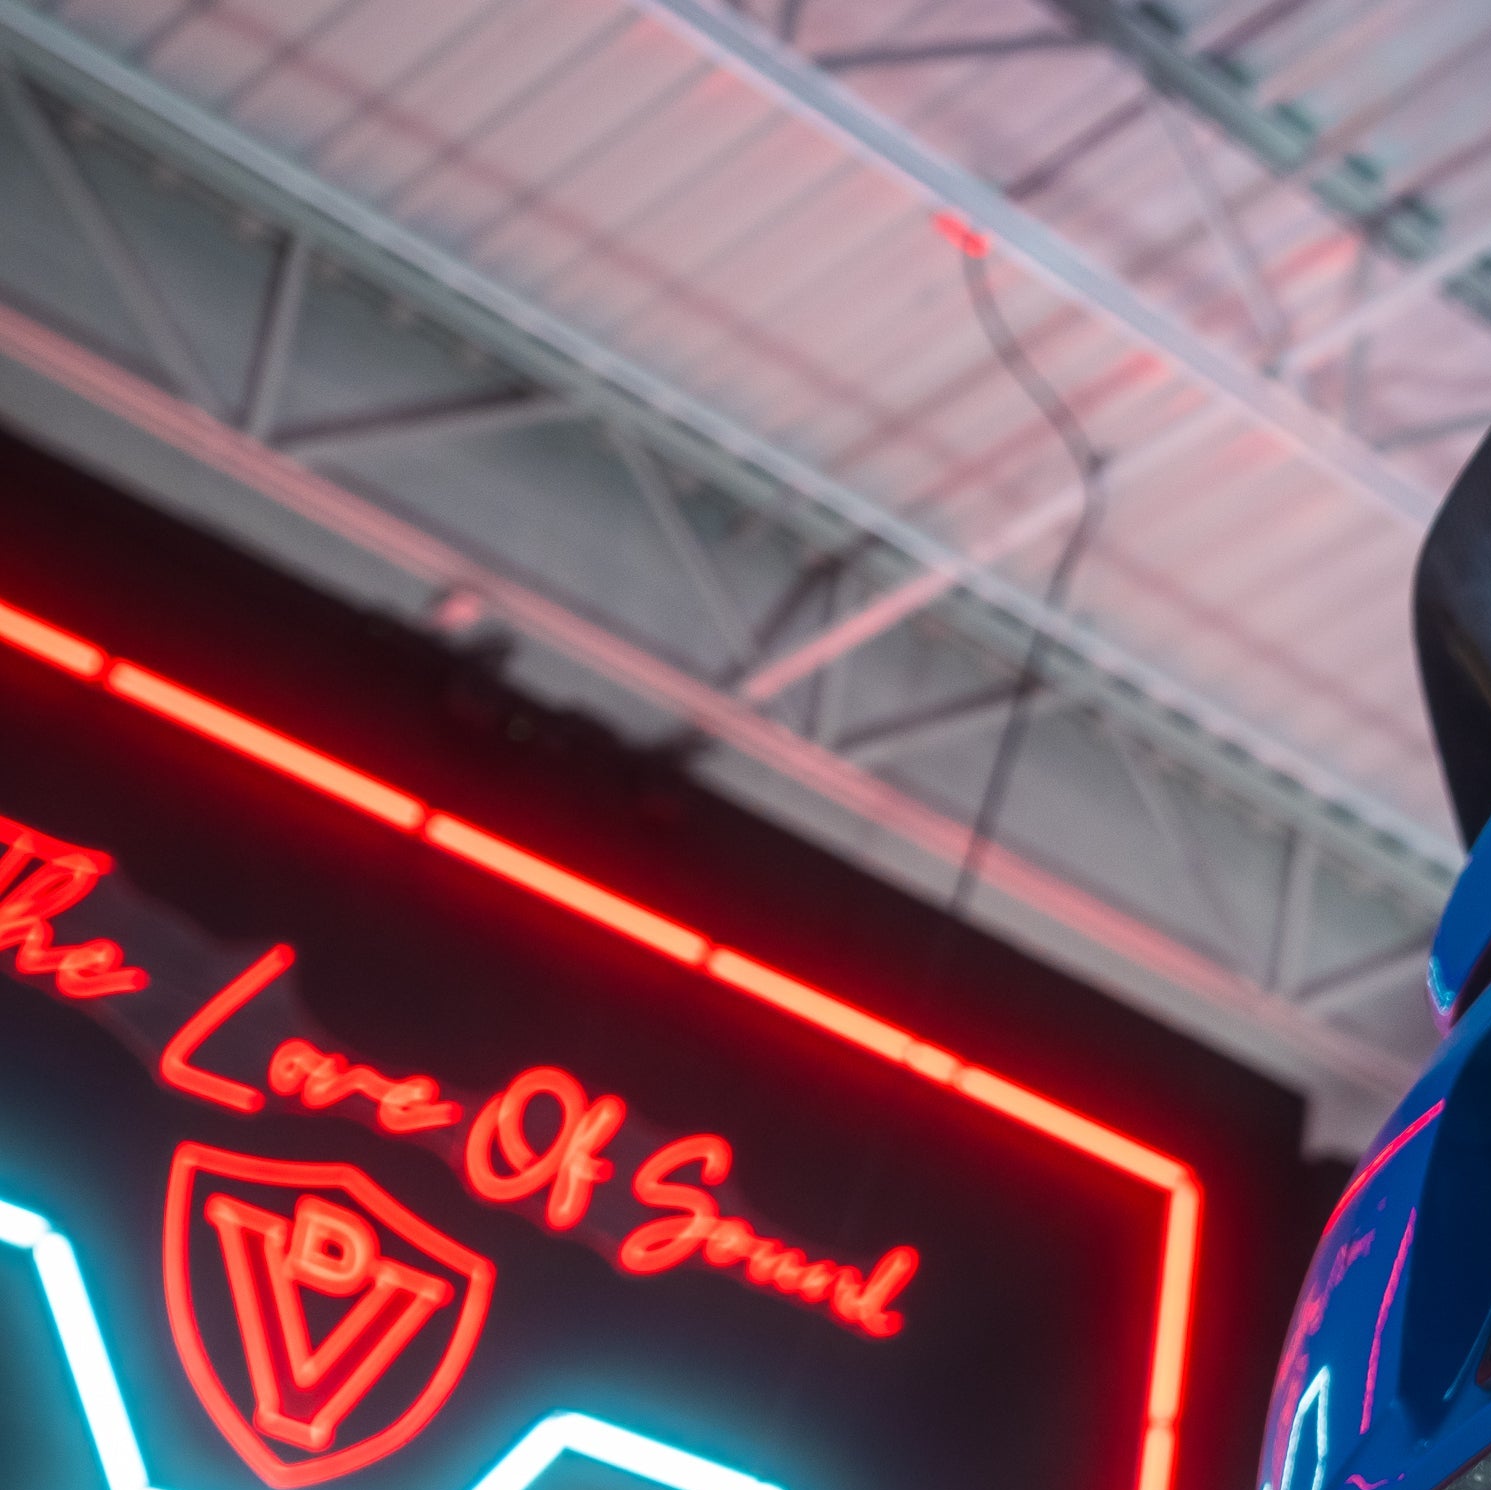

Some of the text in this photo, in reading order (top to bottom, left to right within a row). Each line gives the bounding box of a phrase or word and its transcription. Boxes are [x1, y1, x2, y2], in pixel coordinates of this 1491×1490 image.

[159, 943, 463, 1133] Love
[465, 1066, 627, 1232] Of
[620, 1133, 920, 1339] Sound
